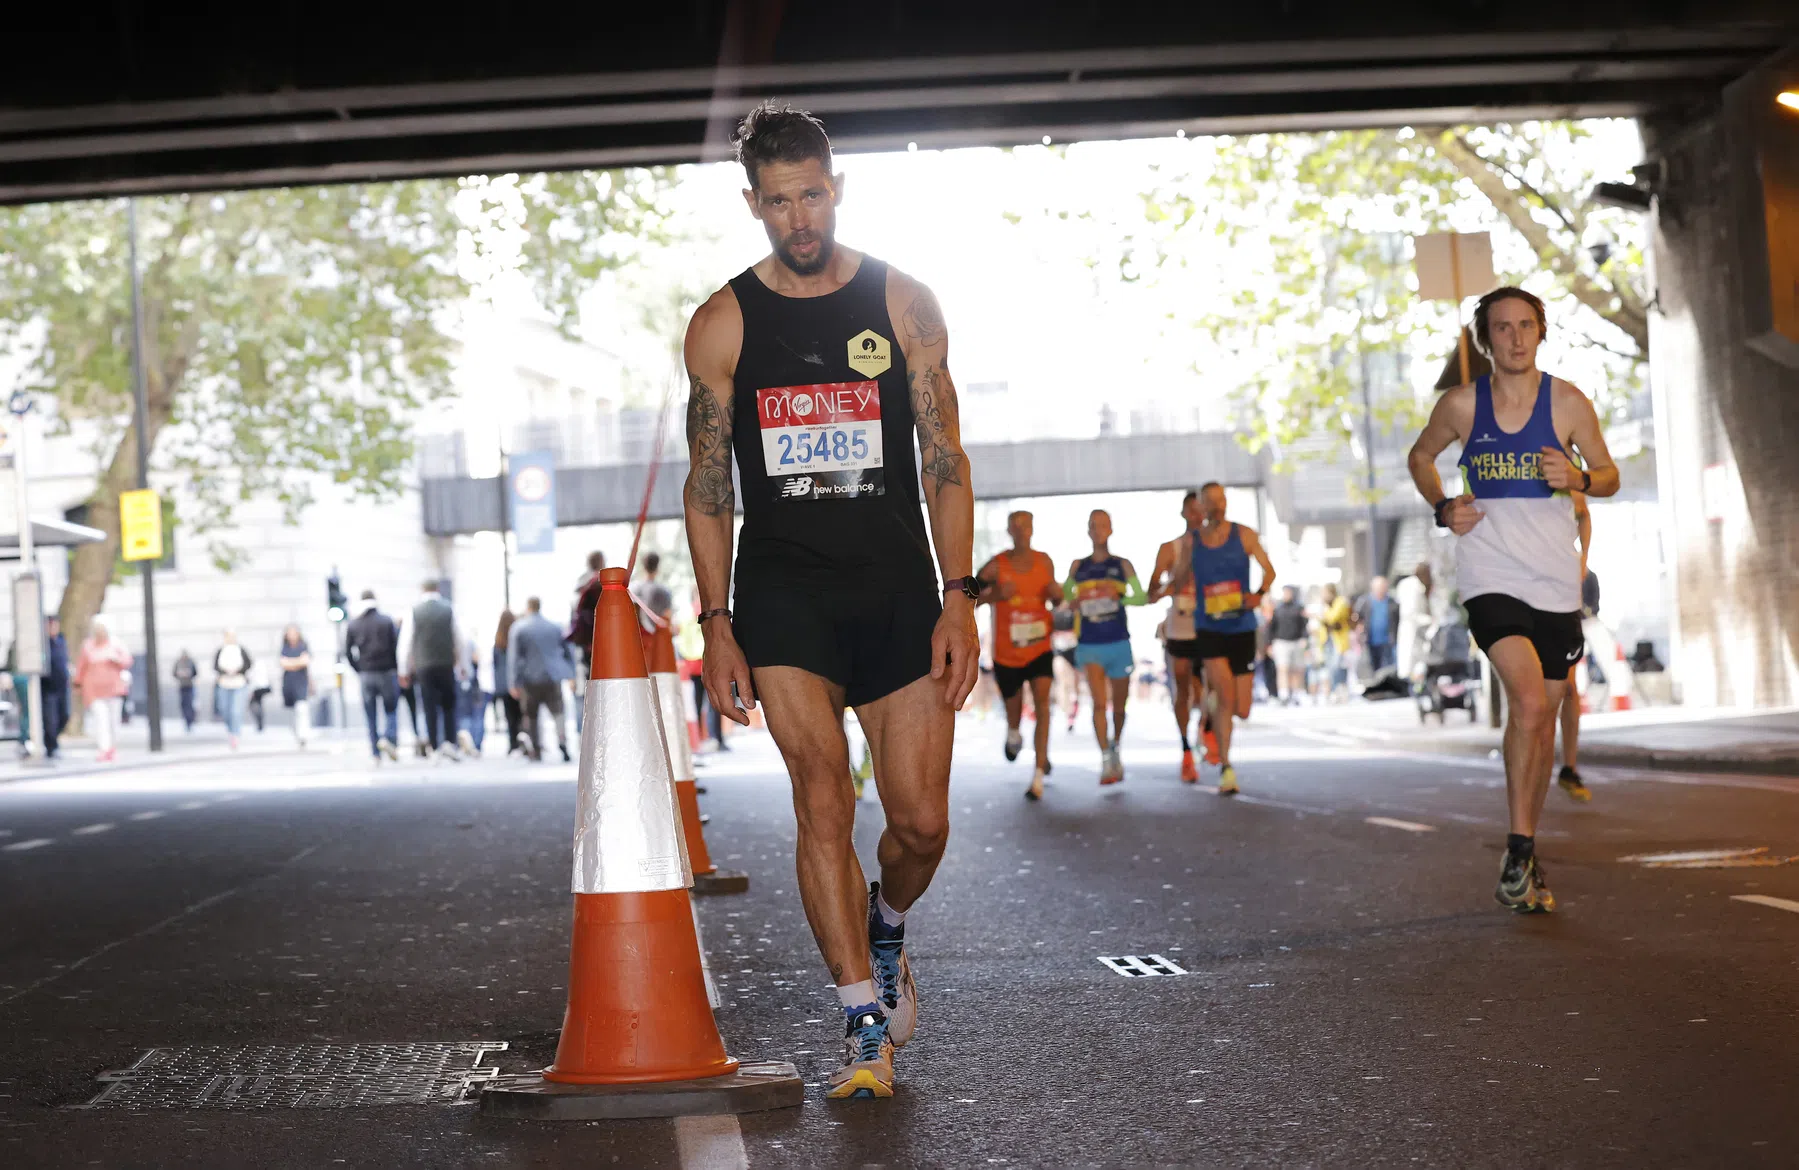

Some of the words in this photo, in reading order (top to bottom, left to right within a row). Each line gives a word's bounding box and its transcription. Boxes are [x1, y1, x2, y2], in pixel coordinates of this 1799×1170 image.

[793, 397, 811, 412] Virgin
[778, 429, 868, 465] 25485
[1469, 452, 1516, 467] WELLS
[1520, 452, 1545, 467] CIT
[814, 486, 832, 494] new
[834, 482, 874, 494] balance
